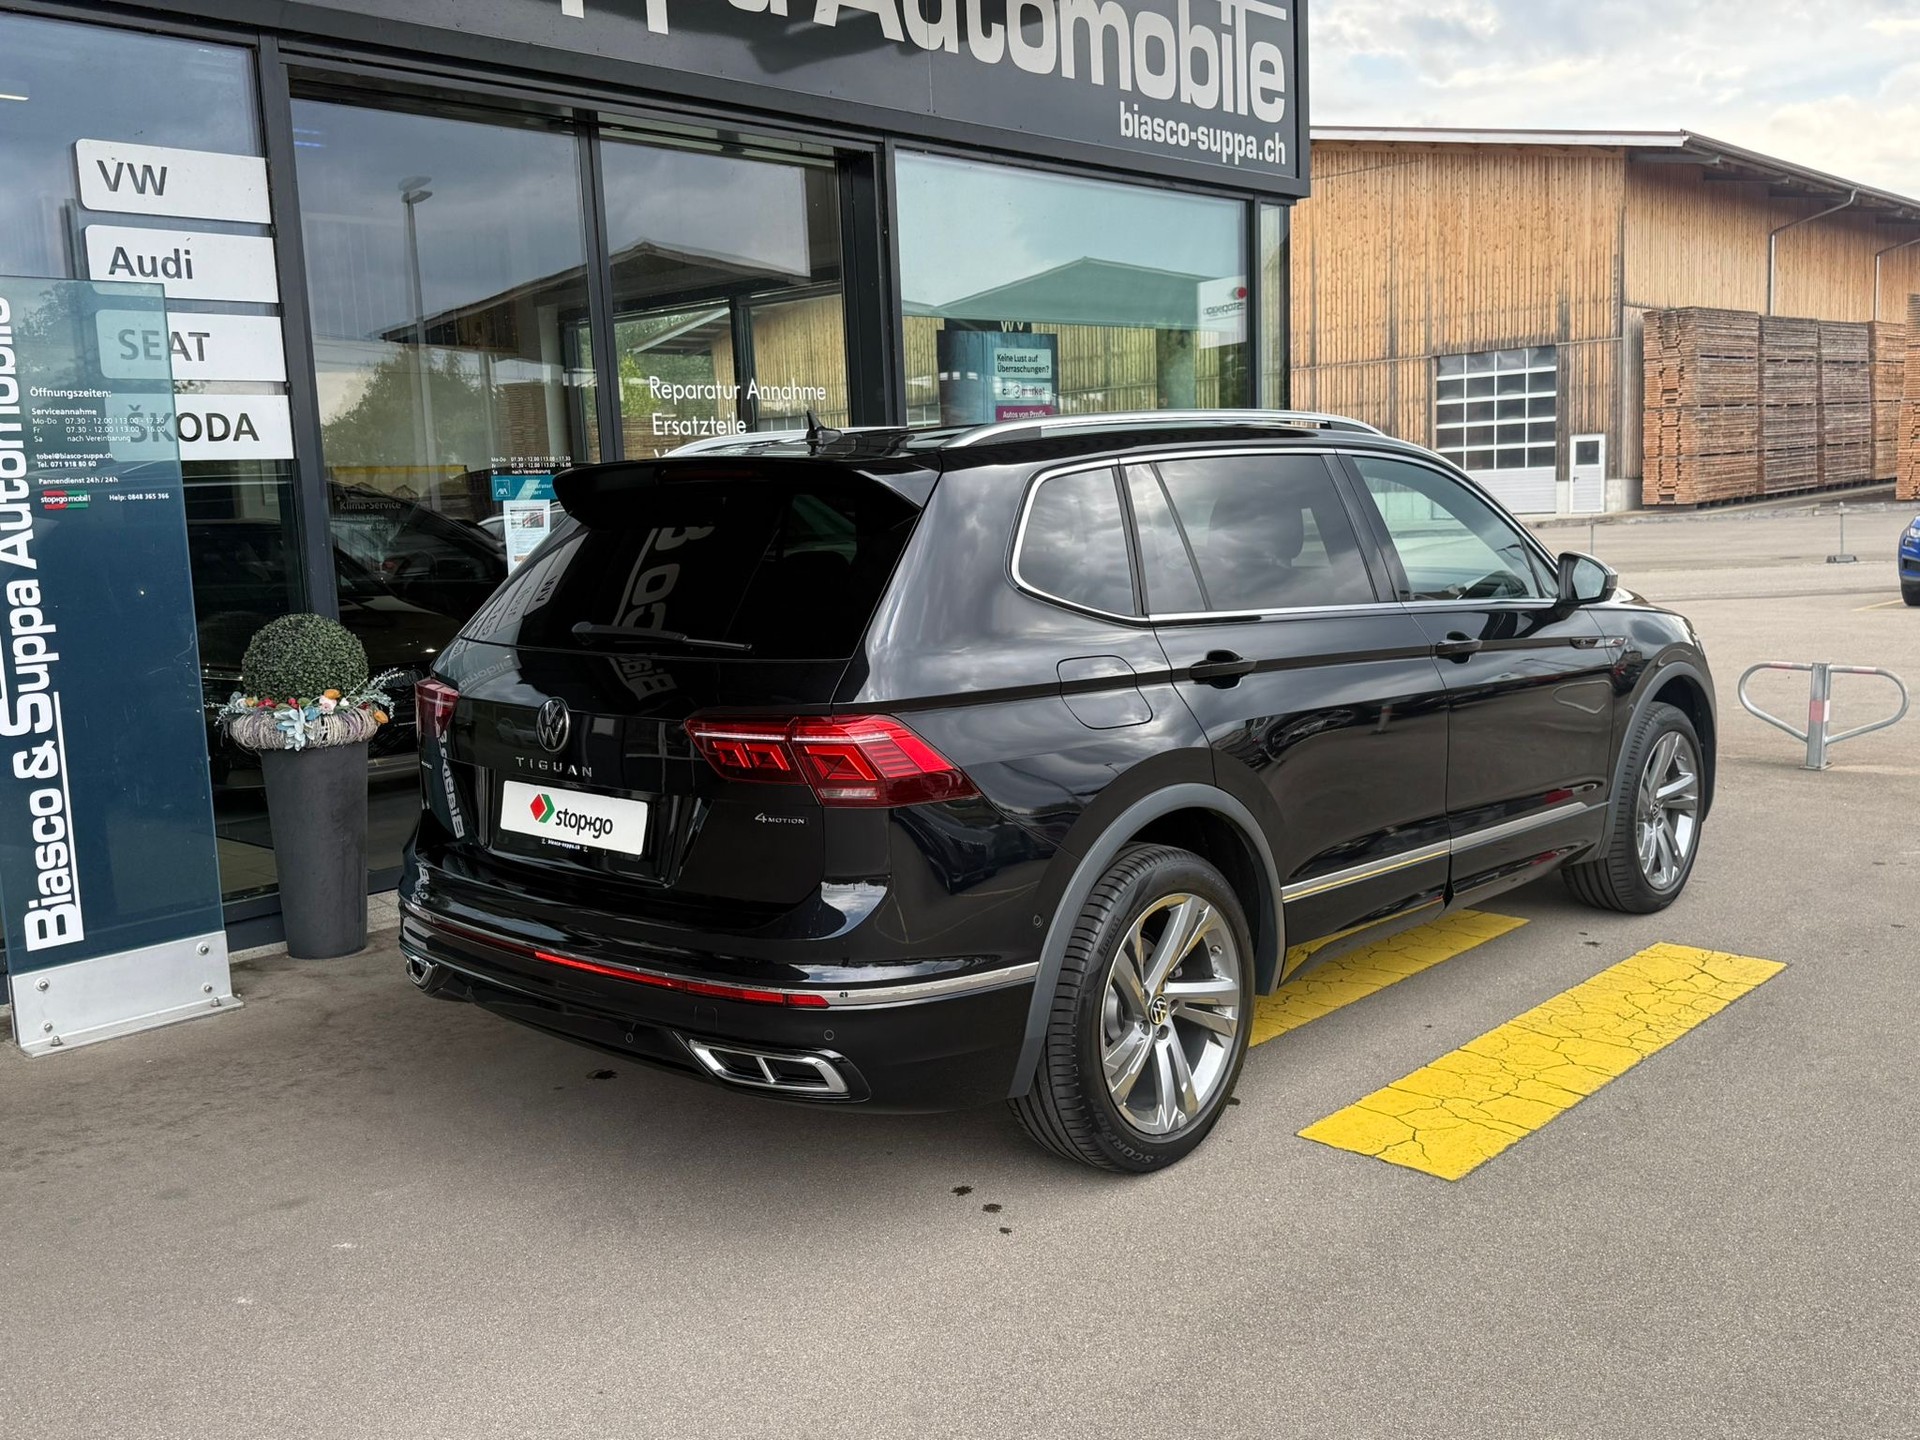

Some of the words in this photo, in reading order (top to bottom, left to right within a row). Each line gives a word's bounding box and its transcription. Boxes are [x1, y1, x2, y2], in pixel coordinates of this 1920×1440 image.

[1119, 101, 1286, 165] biasco-suppa.ch
[96, 159, 168, 197] VW
[108, 246, 193, 280] Audi
[117, 328, 210, 362] SEAT
[997, 353, 1013, 362] Keine
[1014, 354, 1027, 363] Lust
[1028, 354, 1038, 363] auf
[997, 362, 1050, 375] Überraschungen?
[30, 386, 112, 400] Öffnungszeiten:
[649, 375, 741, 405] Reparatur
[746, 378, 826, 400] Annahme
[31, 407, 97, 416] Serviceannahme
[32, 417, 58, 425] Mo-Do
[65, 417, 86, 425] 07.30
[93, 417, 113, 425] 12.00
[120, 417, 139, 425] 13.00
[146, 417, 165, 425] 17.30
[32, 426, 41, 434] Fr
[65, 426, 87, 434] 07.30
[129, 404, 260, 442] ŠKODA
[652, 411, 747, 436] Ersatzteile
[33, 435, 43, 443] Sa
[66, 434, 85, 442] nach
[85, 434, 132, 444] Vereinbarung
[36, 452, 114, 461] tobel@biasco-suppa.ch
[38, 477, 86, 485] Pannendienst
[109, 494, 127, 502] Help:
[127, 493, 144, 501] 0848
[0, 579, 59, 737] Suppa
[13, 740, 60, 780] &
[515, 756, 594, 778] TIGUAN
[555, 808, 614, 839] stop+go
[754, 812, 805, 825] 4MOTION
[24, 787, 84, 952] Biasco
